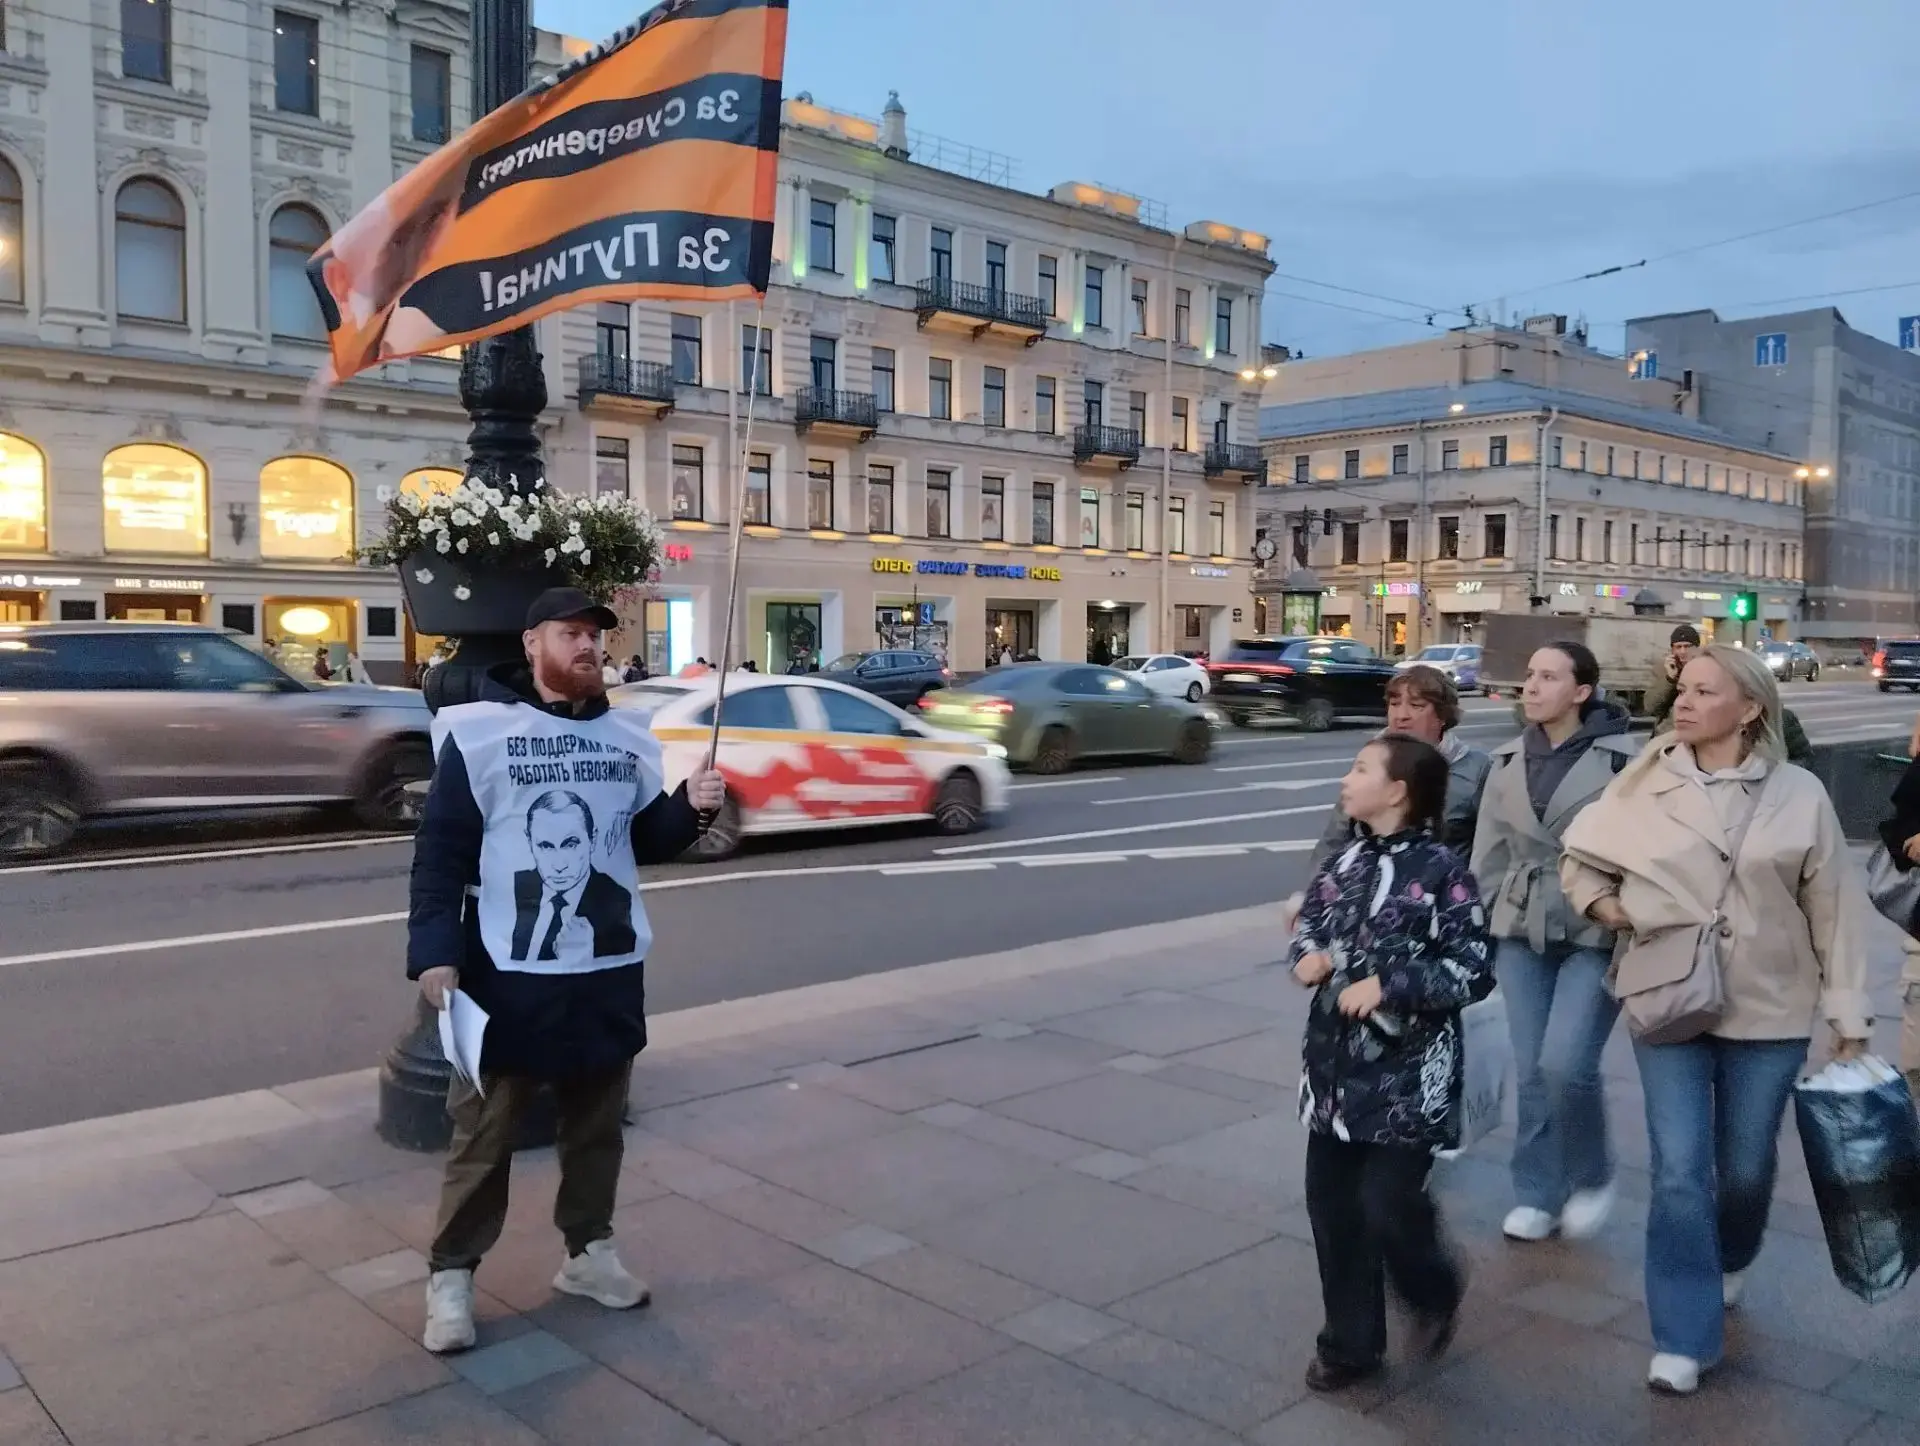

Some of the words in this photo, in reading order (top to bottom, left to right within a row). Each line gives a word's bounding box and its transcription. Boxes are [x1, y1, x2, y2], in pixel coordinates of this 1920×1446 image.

[873, 558, 913, 574] ОТЕЛЬ
[1030, 566, 1063, 581] HOTEL
[1455, 581, 1482, 594] 24/7
[507, 736, 527, 757] БЕЗ
[509, 761, 570, 786] РАБОТАТЬ
